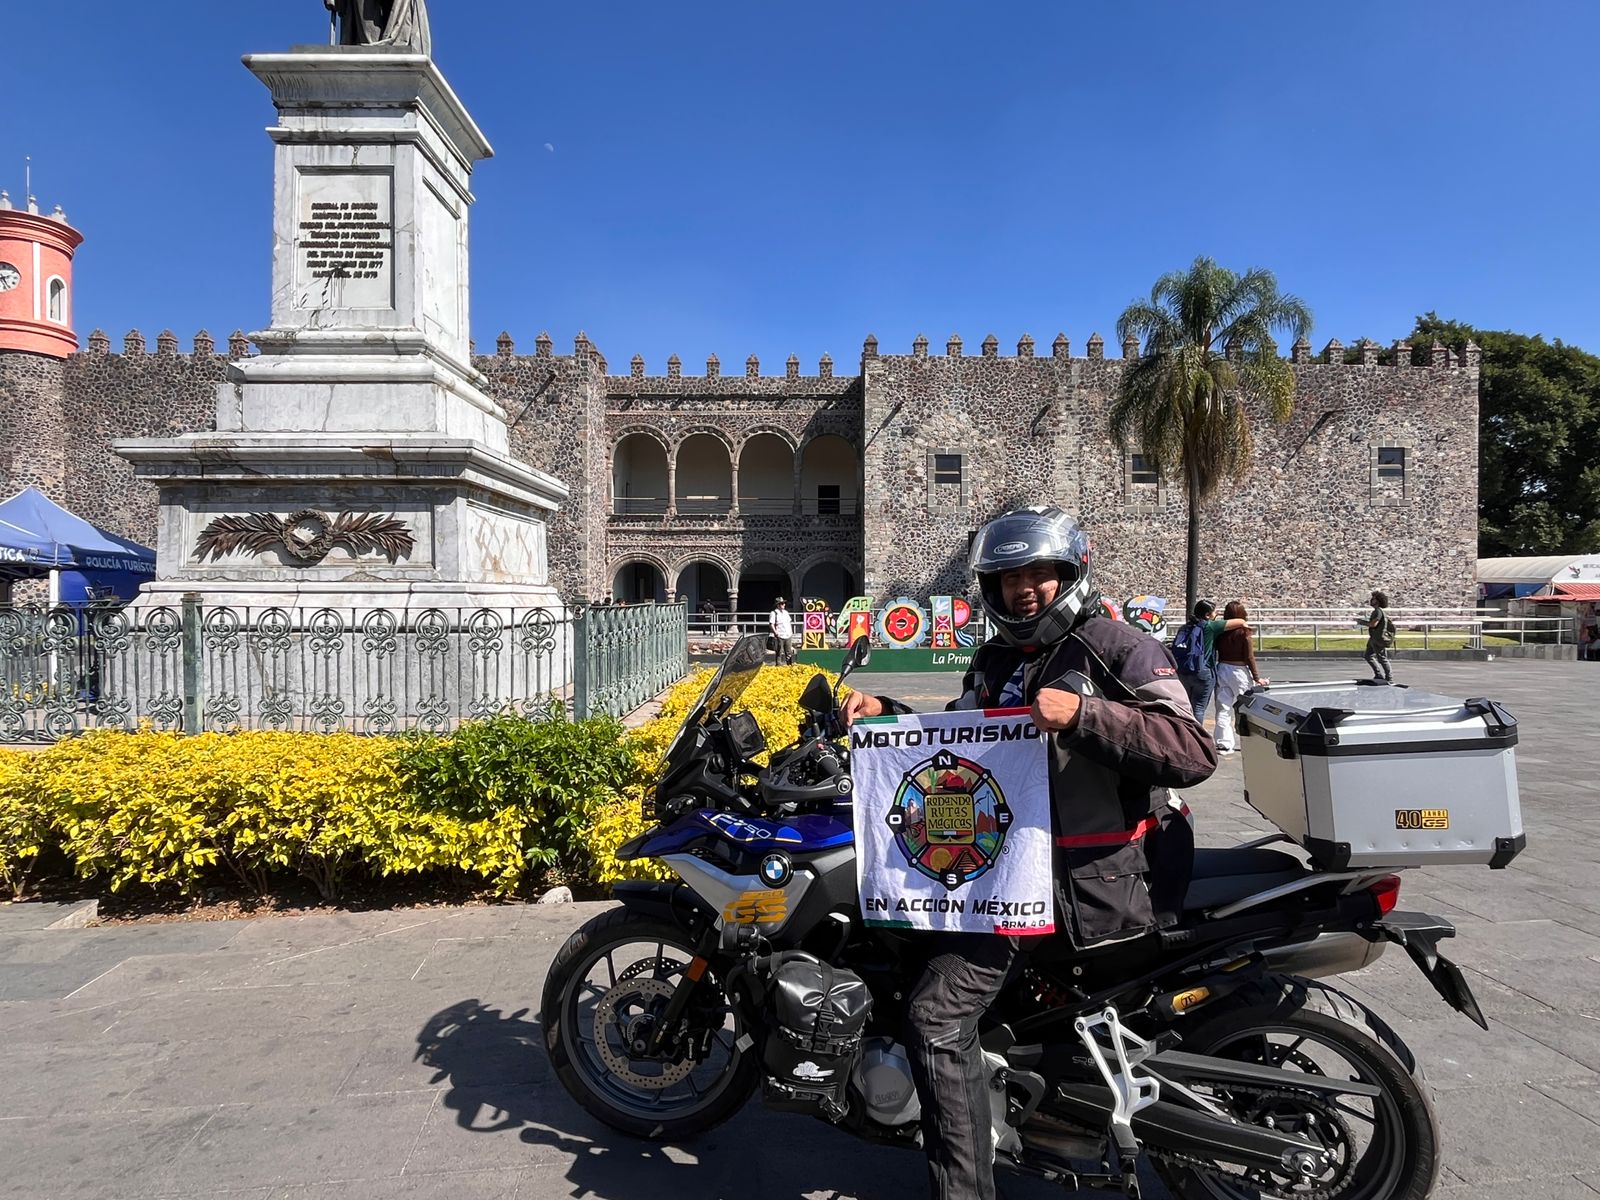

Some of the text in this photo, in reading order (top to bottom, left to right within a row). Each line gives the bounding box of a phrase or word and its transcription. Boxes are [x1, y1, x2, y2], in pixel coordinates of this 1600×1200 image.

[85, 556, 122, 570] POLICÍA
[932, 652, 945, 665] La
[938, 756, 952, 766] N
[889, 814, 902, 825] O
[999, 813, 1009, 823] E
[1397, 811, 1421, 828] 40
[1423, 819, 1447, 828] GS
[946, 873, 958, 885] S
[865, 894, 1046, 916] EN ACCIÓN MÉXICO
